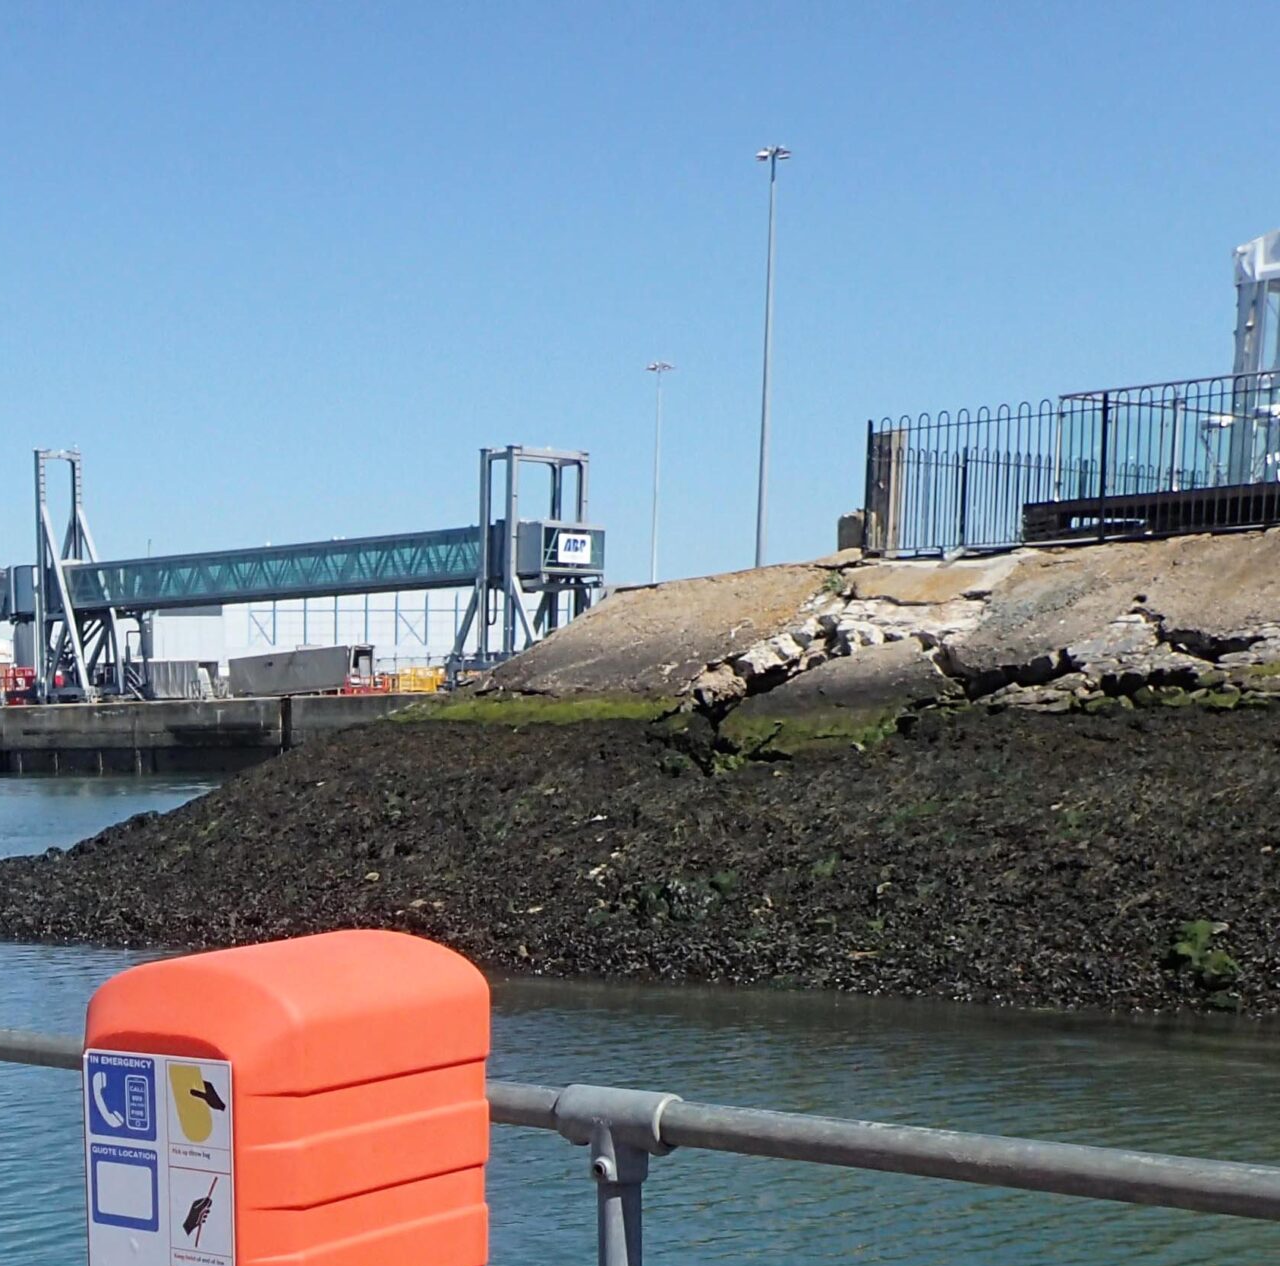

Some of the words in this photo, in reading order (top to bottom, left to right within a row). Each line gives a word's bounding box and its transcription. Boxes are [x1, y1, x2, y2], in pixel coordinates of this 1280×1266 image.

[564, 538, 586, 552] ABP
[90, 1055, 99, 1064] IN
[101, 1056, 152, 1069] EMERGENCY
[91, 1145, 117, 1156] QUOTE
[119, 1149, 156, 1161] LOCATION
